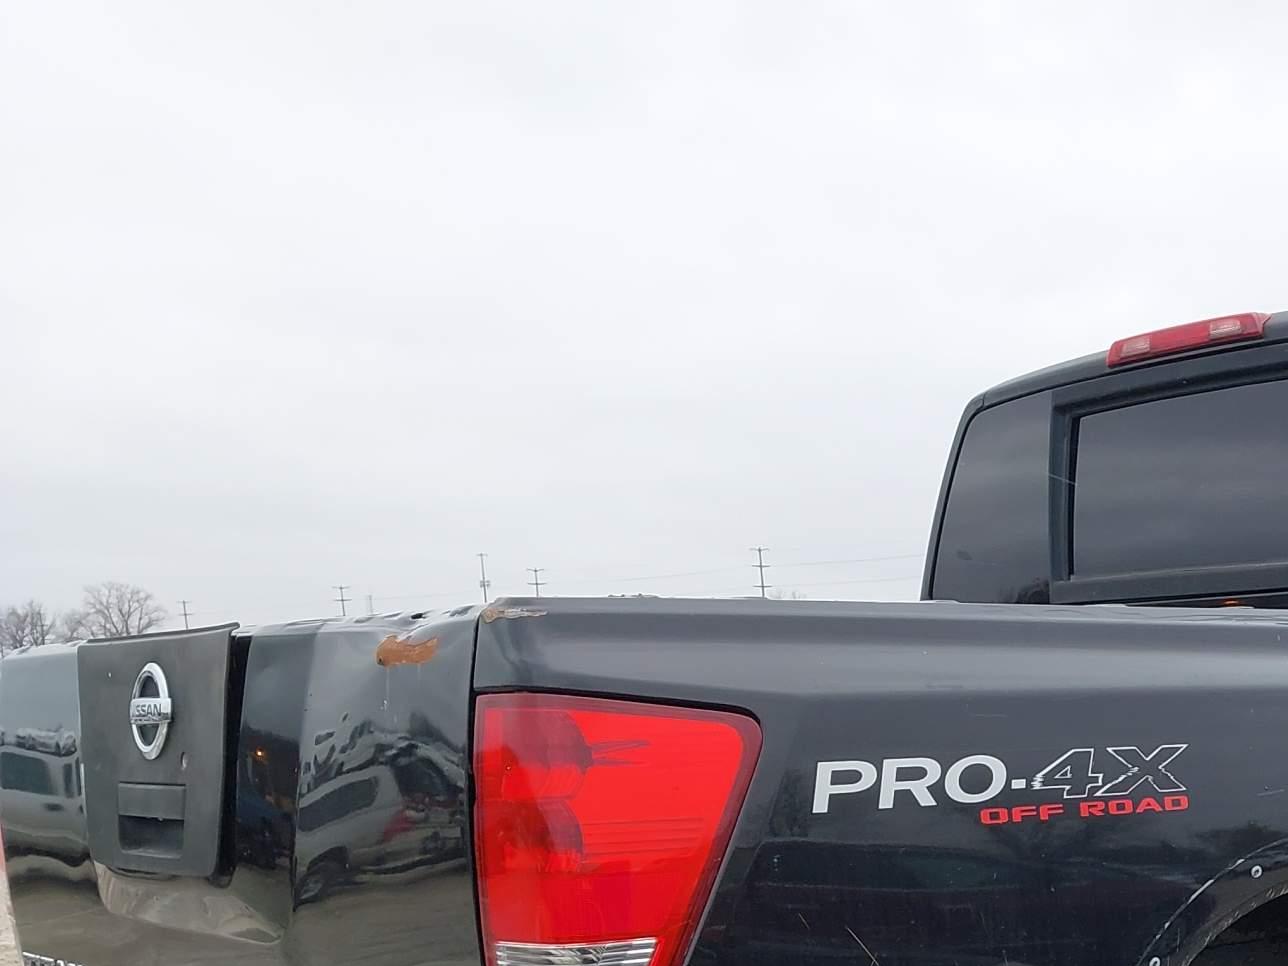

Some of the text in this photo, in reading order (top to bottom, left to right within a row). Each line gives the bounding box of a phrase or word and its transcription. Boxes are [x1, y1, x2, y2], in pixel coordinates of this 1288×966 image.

[131, 703, 162, 717] SSAN
[811, 743, 1190, 814] PRO-4X
[979, 795, 1190, 826] OFF ROAD
